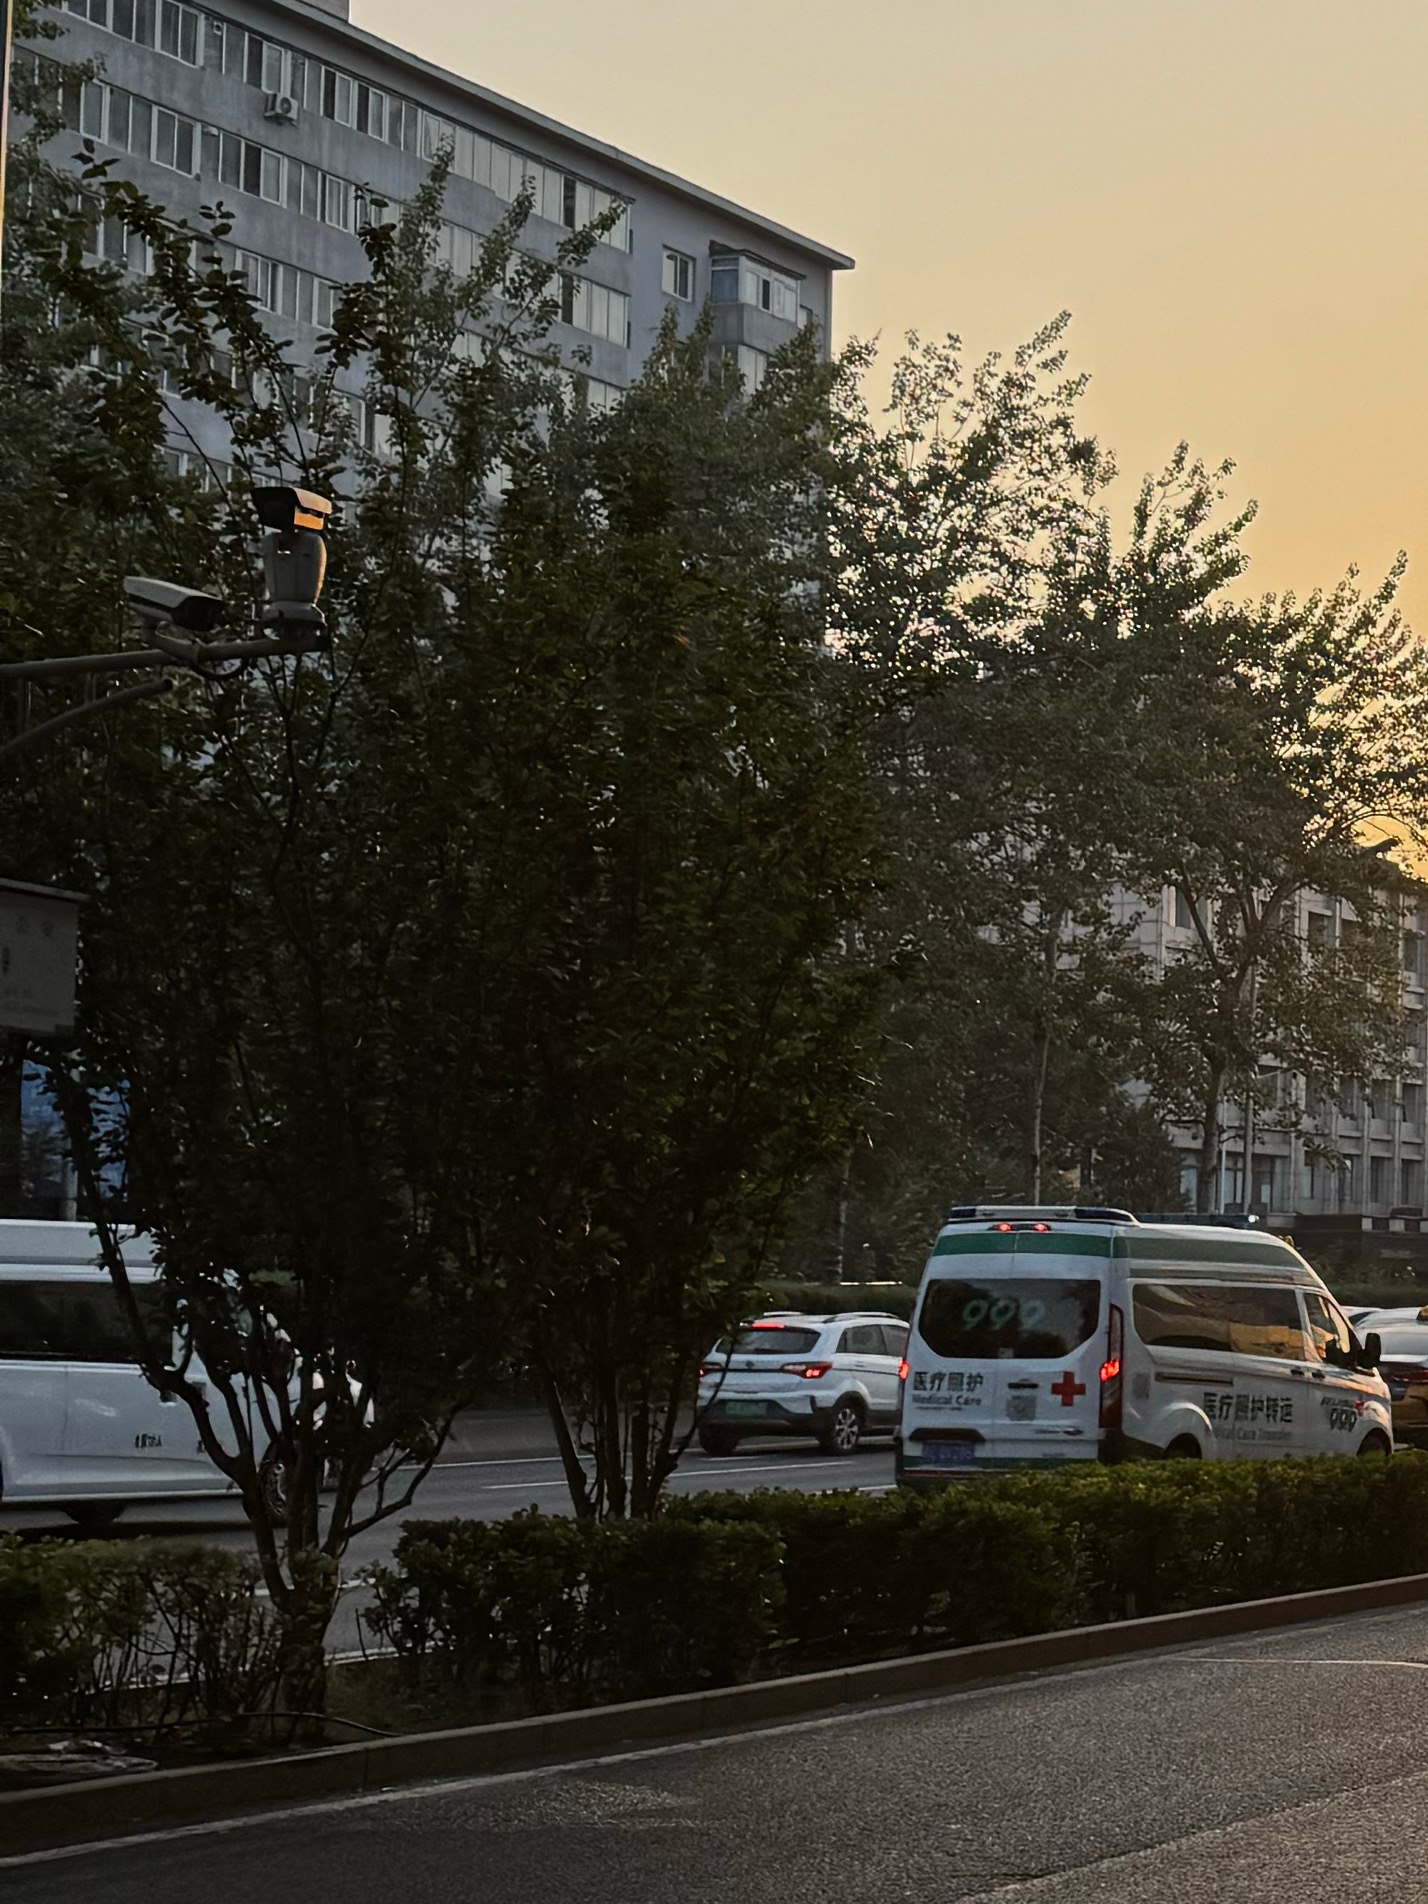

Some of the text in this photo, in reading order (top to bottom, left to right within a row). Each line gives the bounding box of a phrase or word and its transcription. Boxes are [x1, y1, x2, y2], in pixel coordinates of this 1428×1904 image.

[963, 1299, 1046, 1331] 999
[955, 1395, 982, 1406] Care
[1329, 1408, 1358, 1433] 999
